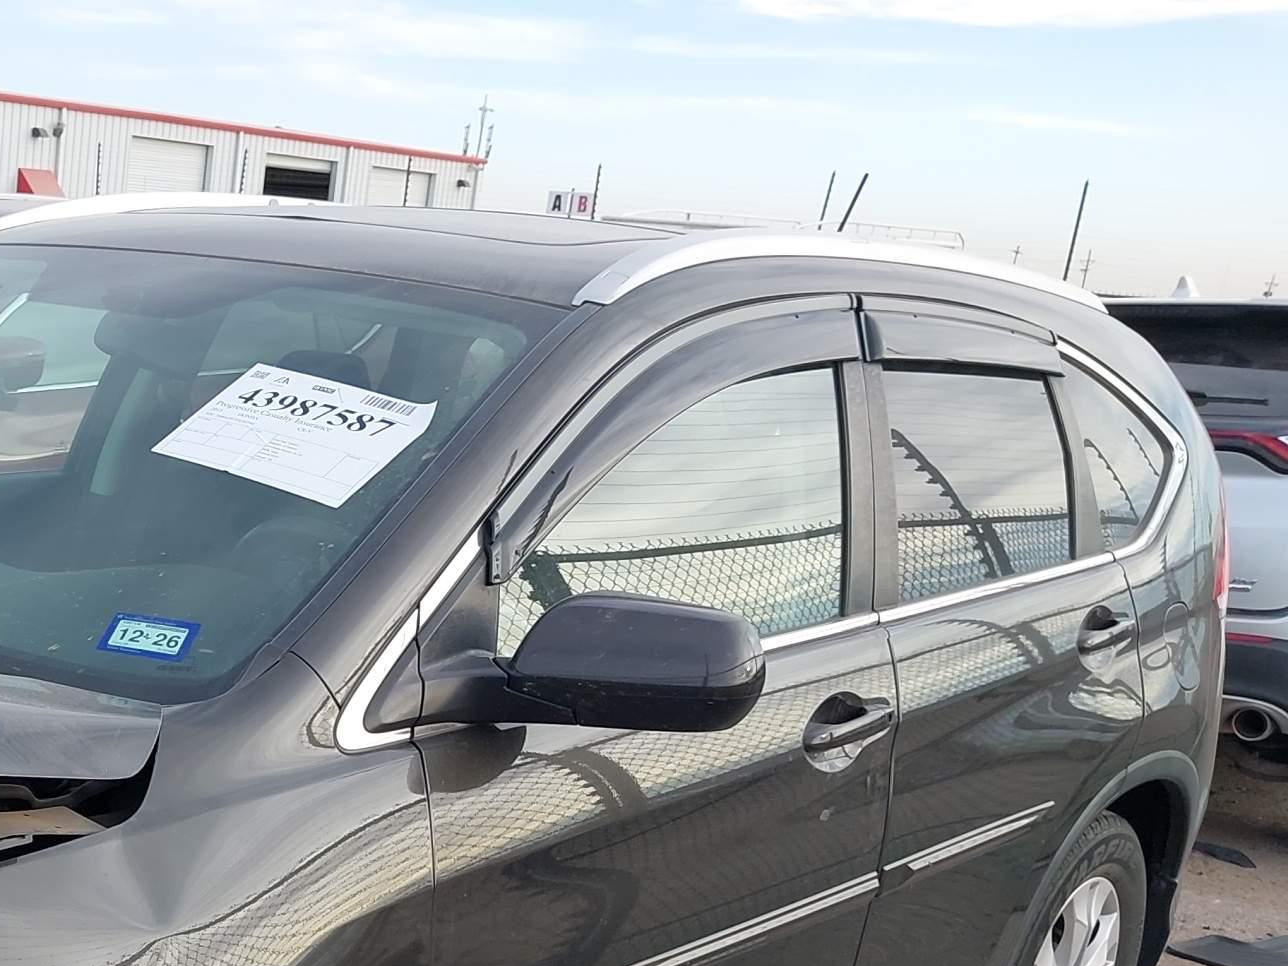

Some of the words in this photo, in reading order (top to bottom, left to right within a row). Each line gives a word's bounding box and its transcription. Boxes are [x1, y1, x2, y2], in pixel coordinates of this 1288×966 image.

[551, 194, 562, 212] A
[577, 195, 589, 213] B
[237, 388, 397, 437] 43987587
[119, 627, 145, 643] 12
[152, 632, 182, 649] 26
